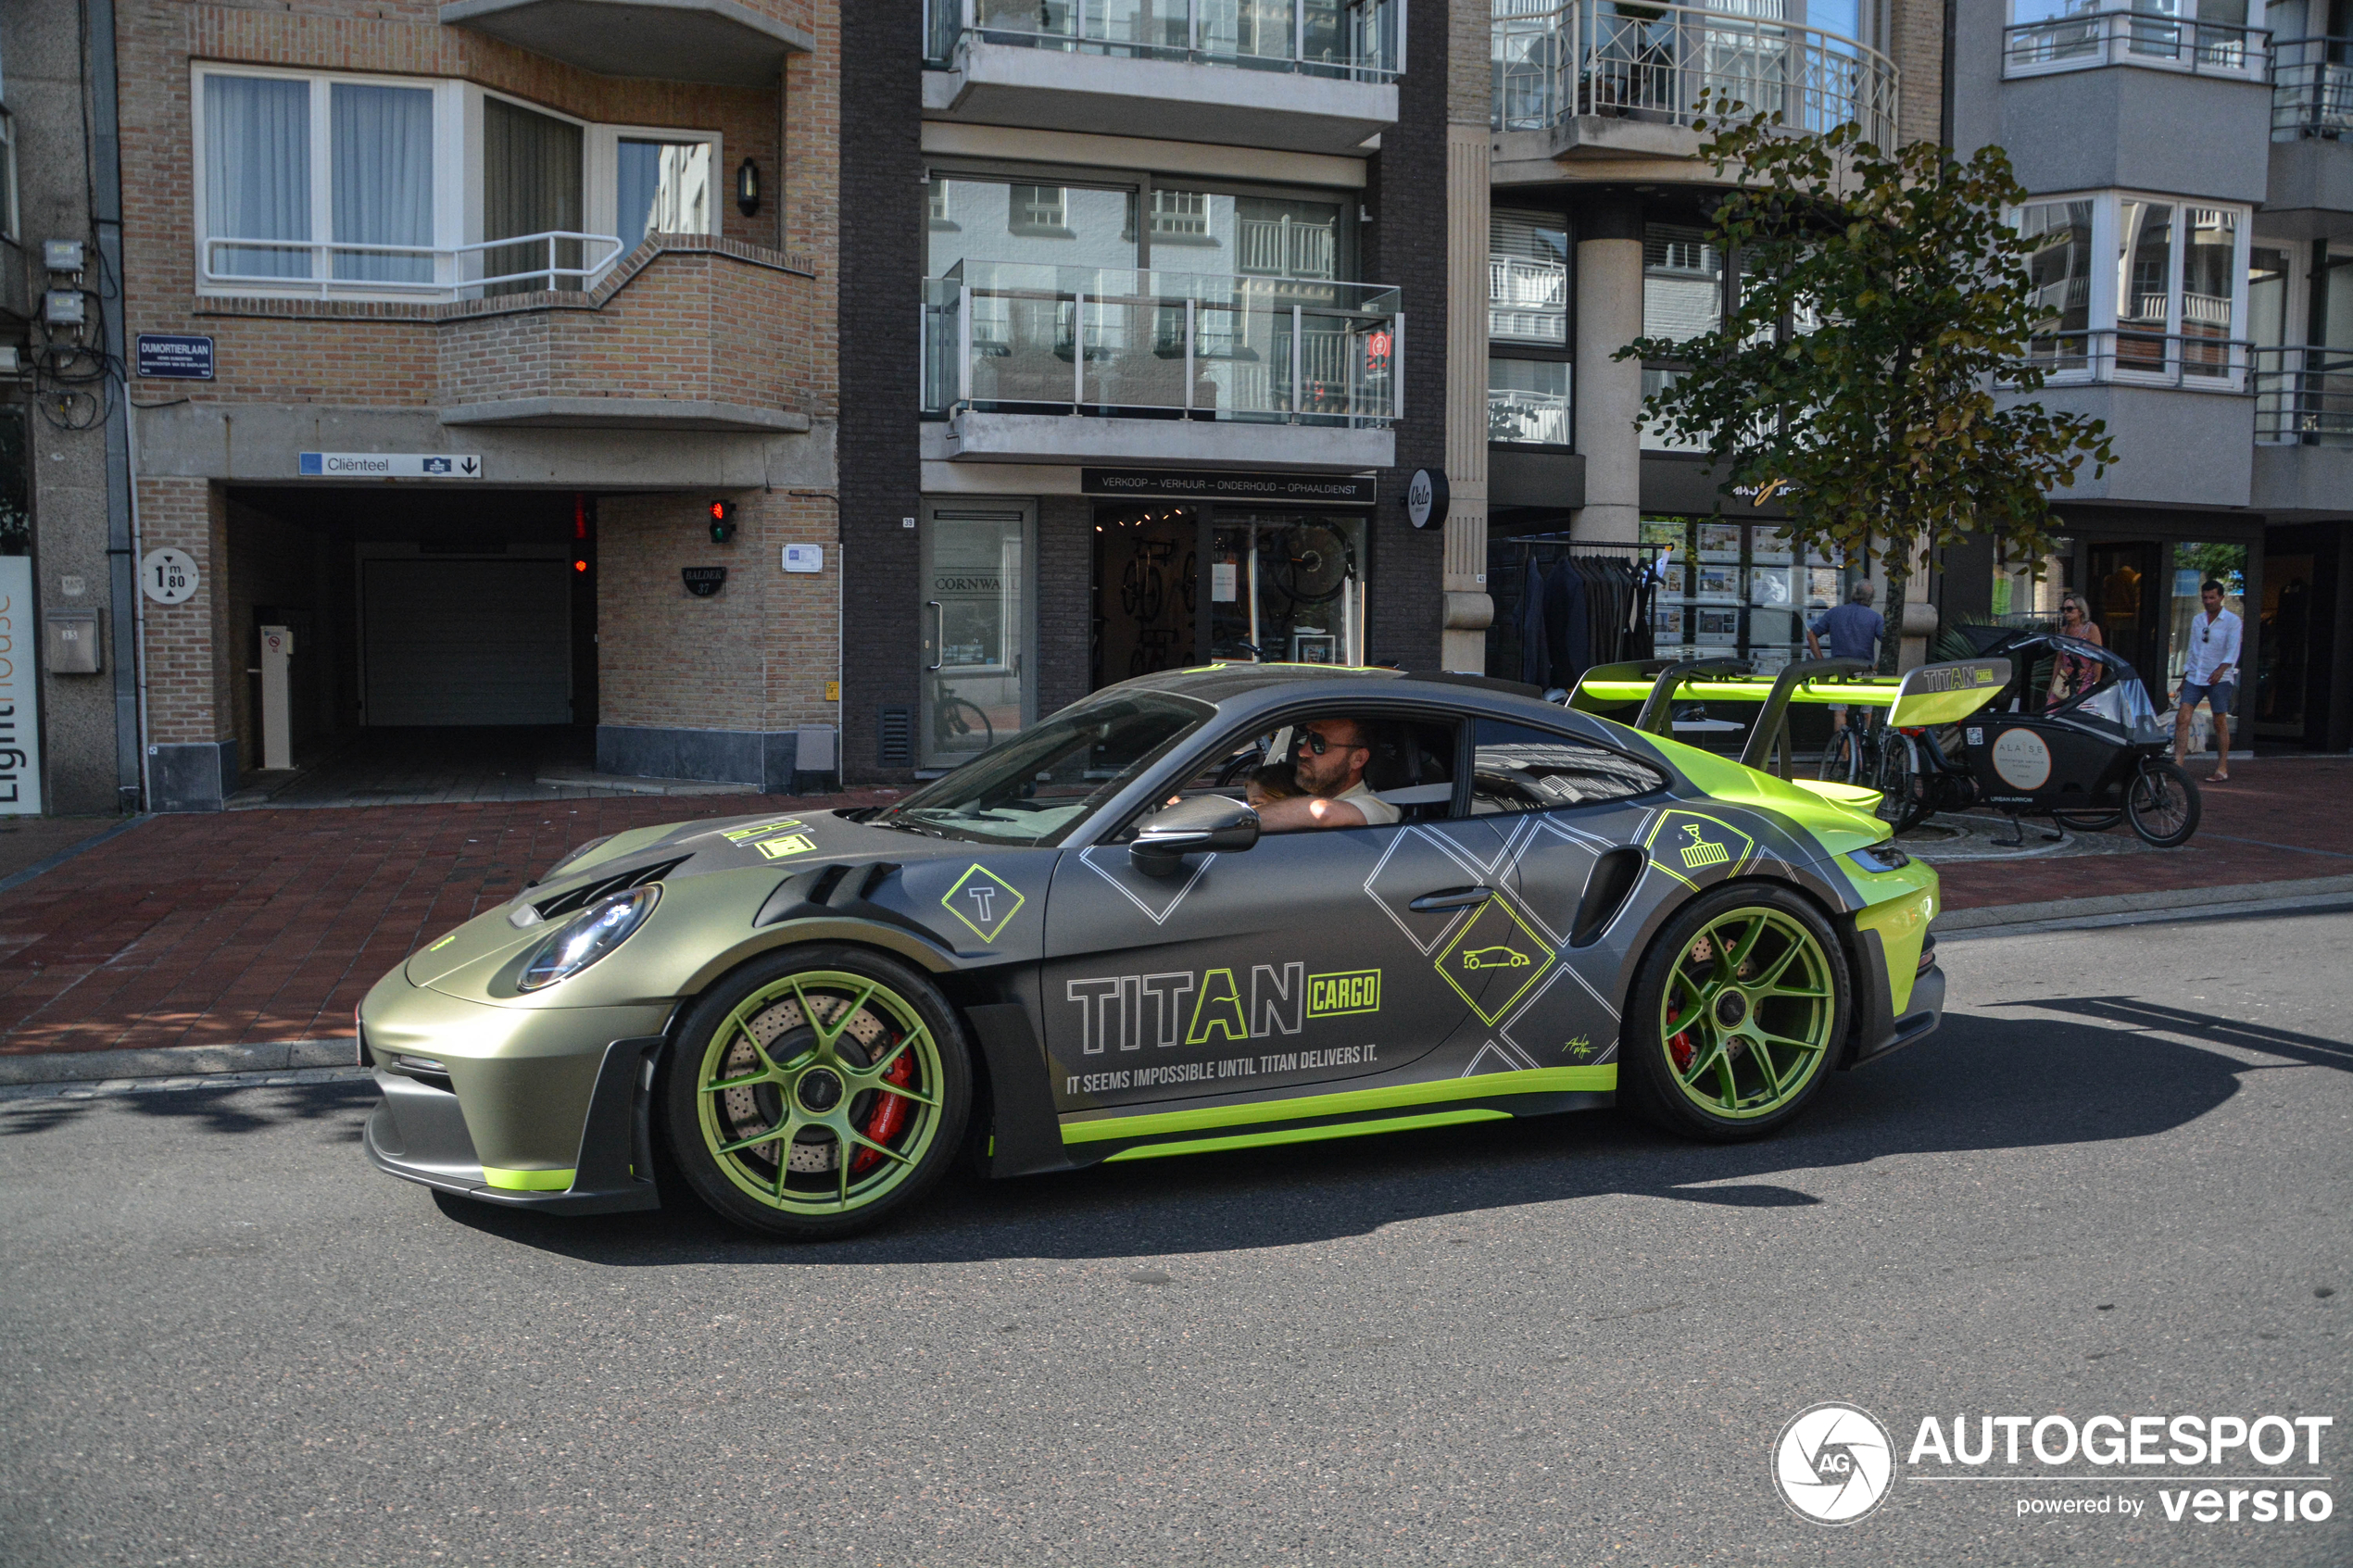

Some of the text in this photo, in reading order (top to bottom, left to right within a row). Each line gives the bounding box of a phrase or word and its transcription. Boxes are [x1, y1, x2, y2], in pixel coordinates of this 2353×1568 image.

[141, 342, 209, 356] DUMORTIERLAAN
[327, 457, 389, 471] Cliënteel
[1101, 476, 1357, 495] VERKOOP VERHUUR ONDERHOUD OPHAALDIENST
[1411, 484, 1430, 506] Velo
[156, 565, 182, 588] 1 m
[169, 575, 185, 588] 80
[686, 570, 723, 581] BALDER
[935, 577, 1021, 591] CORNWAL
[698, 583, 710, 595] 37
[1923, 666, 1977, 692] TITAN
[967, 886, 996, 922] T
[1066, 961, 1376, 1055] TITAN CARGO
[1066, 1044, 1378, 1095] IT SEEMS IMPOSSIBLE UNTIL TITAN DELIVERS IT.
